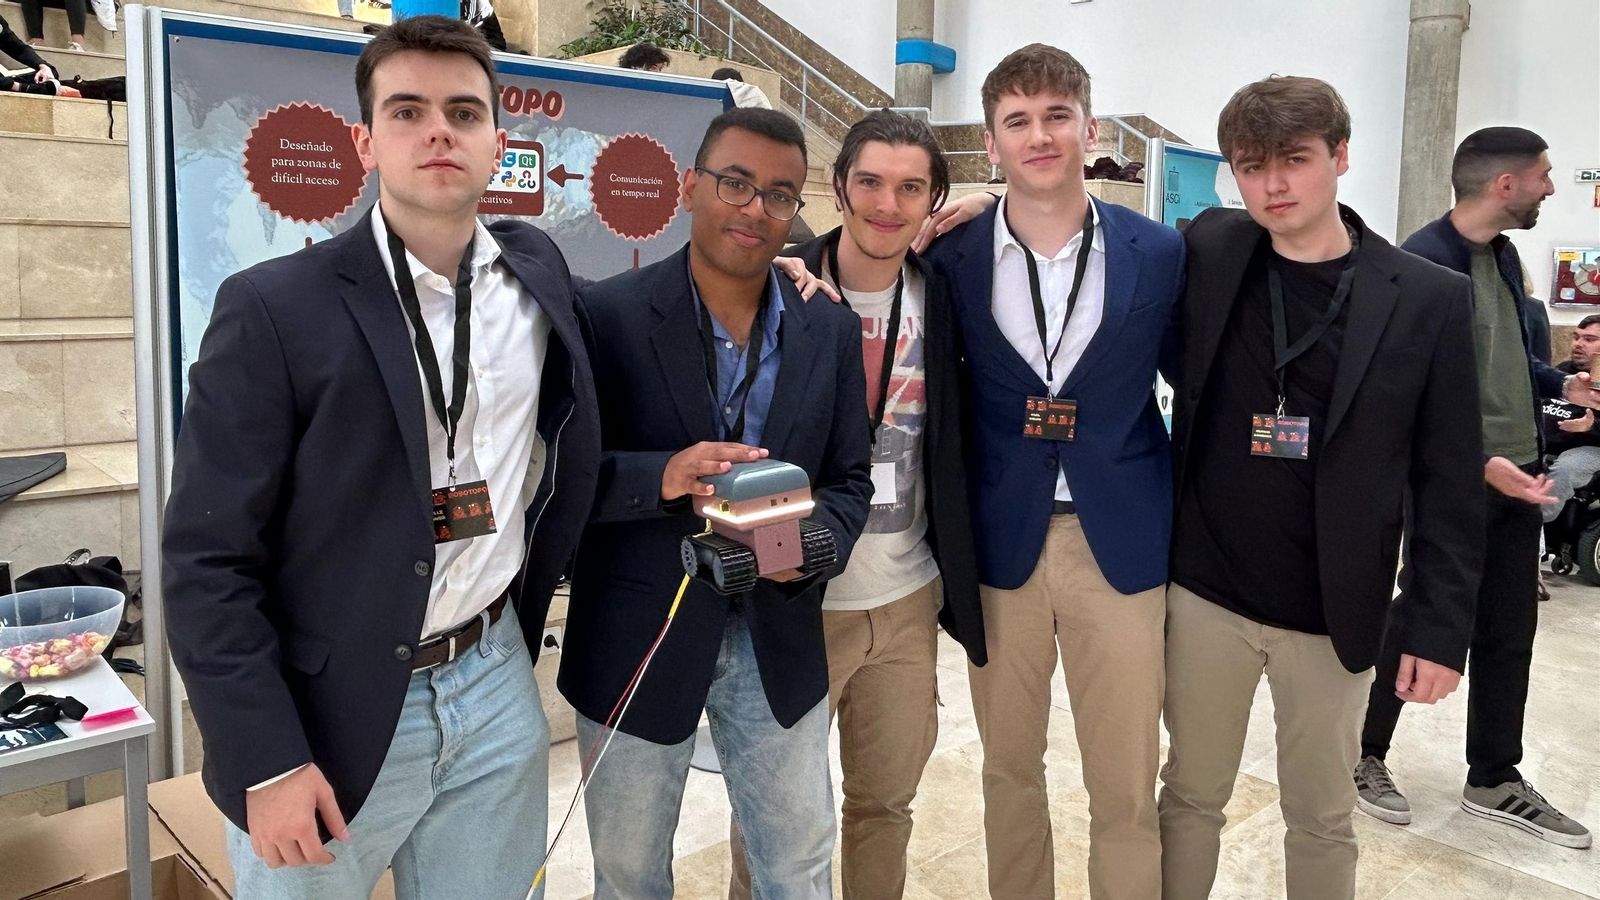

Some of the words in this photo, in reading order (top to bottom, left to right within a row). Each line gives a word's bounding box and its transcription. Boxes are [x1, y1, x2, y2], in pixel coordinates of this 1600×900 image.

[280, 138, 333, 152] Deseñado
[271, 158, 295, 168] para
[297, 160, 327, 168] zonas
[329, 158, 342, 169] de
[521, 156, 533, 167] Qt
[305, 177, 339, 185] acceso
[609, 173, 663, 185] Comunicación
[611, 189, 621, 197] en
[622, 189, 645, 199] tempo
[646, 189, 660, 198] real
